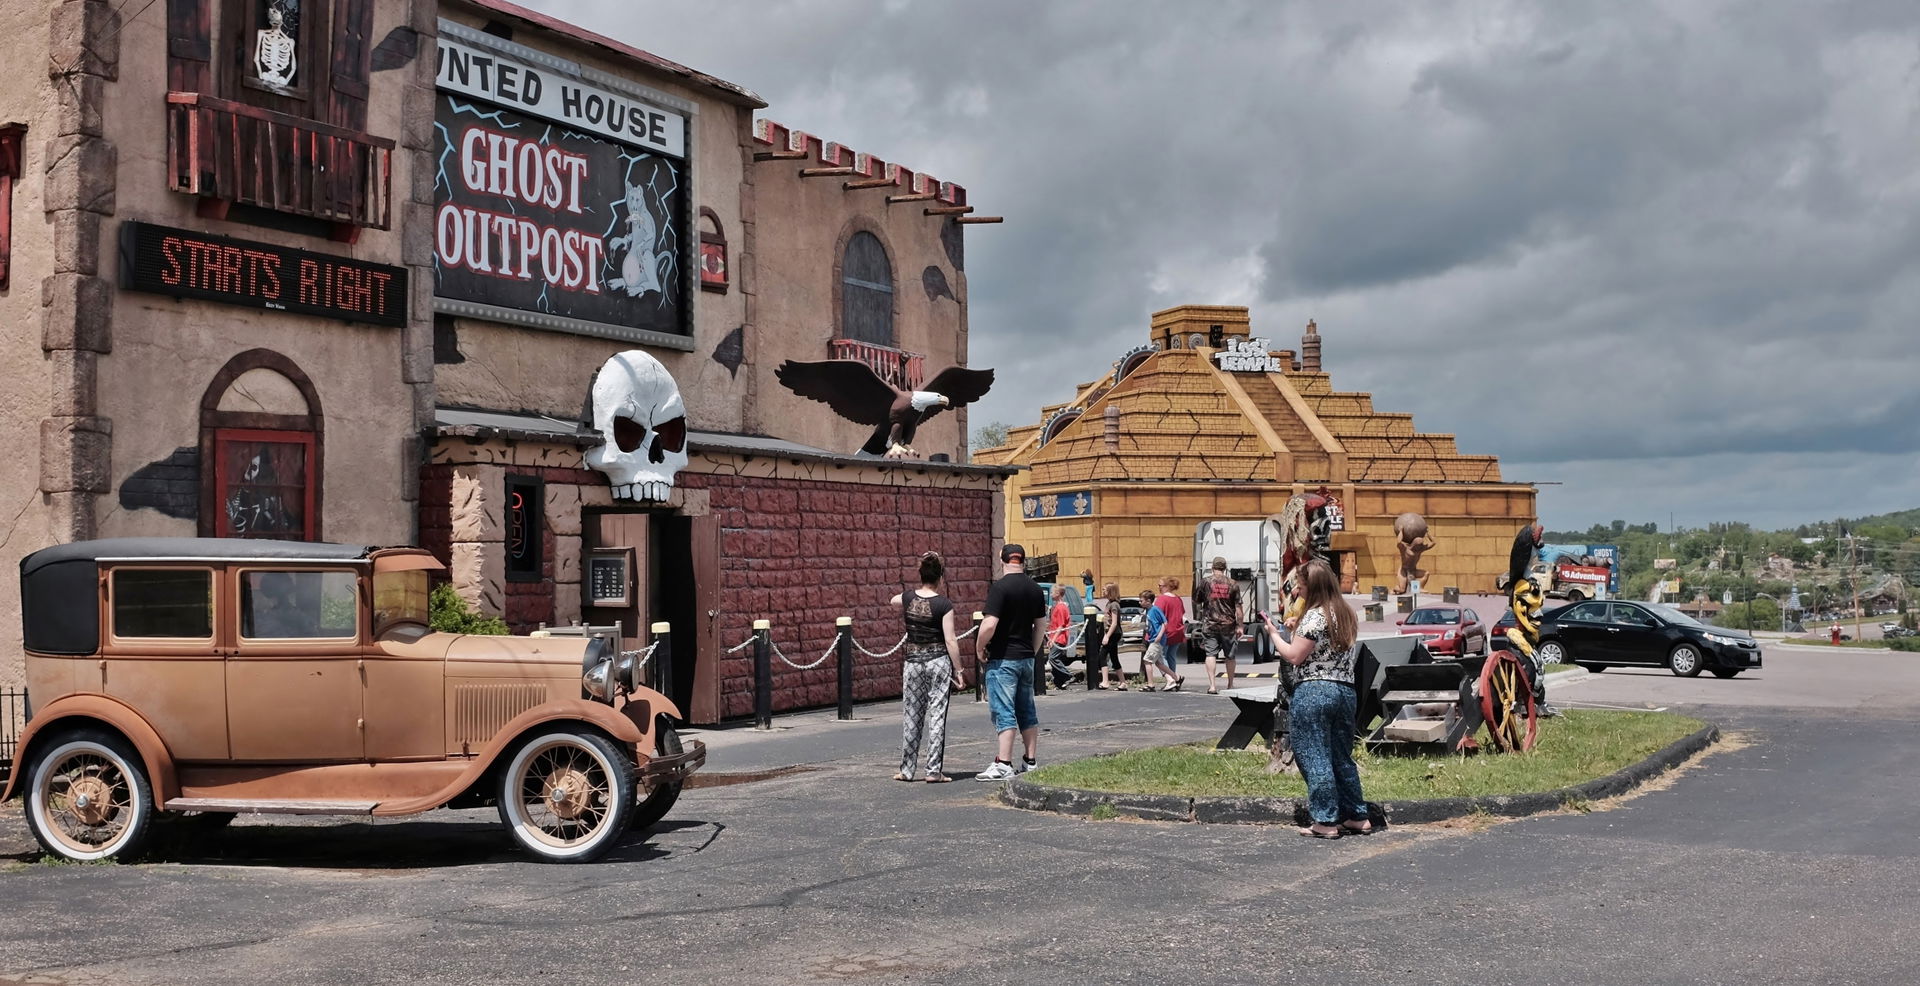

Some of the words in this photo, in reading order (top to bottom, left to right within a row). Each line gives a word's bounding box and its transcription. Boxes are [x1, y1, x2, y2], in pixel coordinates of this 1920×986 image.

[562, 86, 667, 147] HOUSE
[462, 128, 587, 214] GHOST
[438, 205, 603, 292] OUTPOST
[161, 236, 281, 299] STARTS
[300, 258, 391, 316] RIGHT
[1215, 352, 1282, 372] TEMPLE
[1227, 338, 1271, 357] LOST
[1593, 548, 1613, 557] GHOST
[1571, 571, 1606, 581] Adventure
